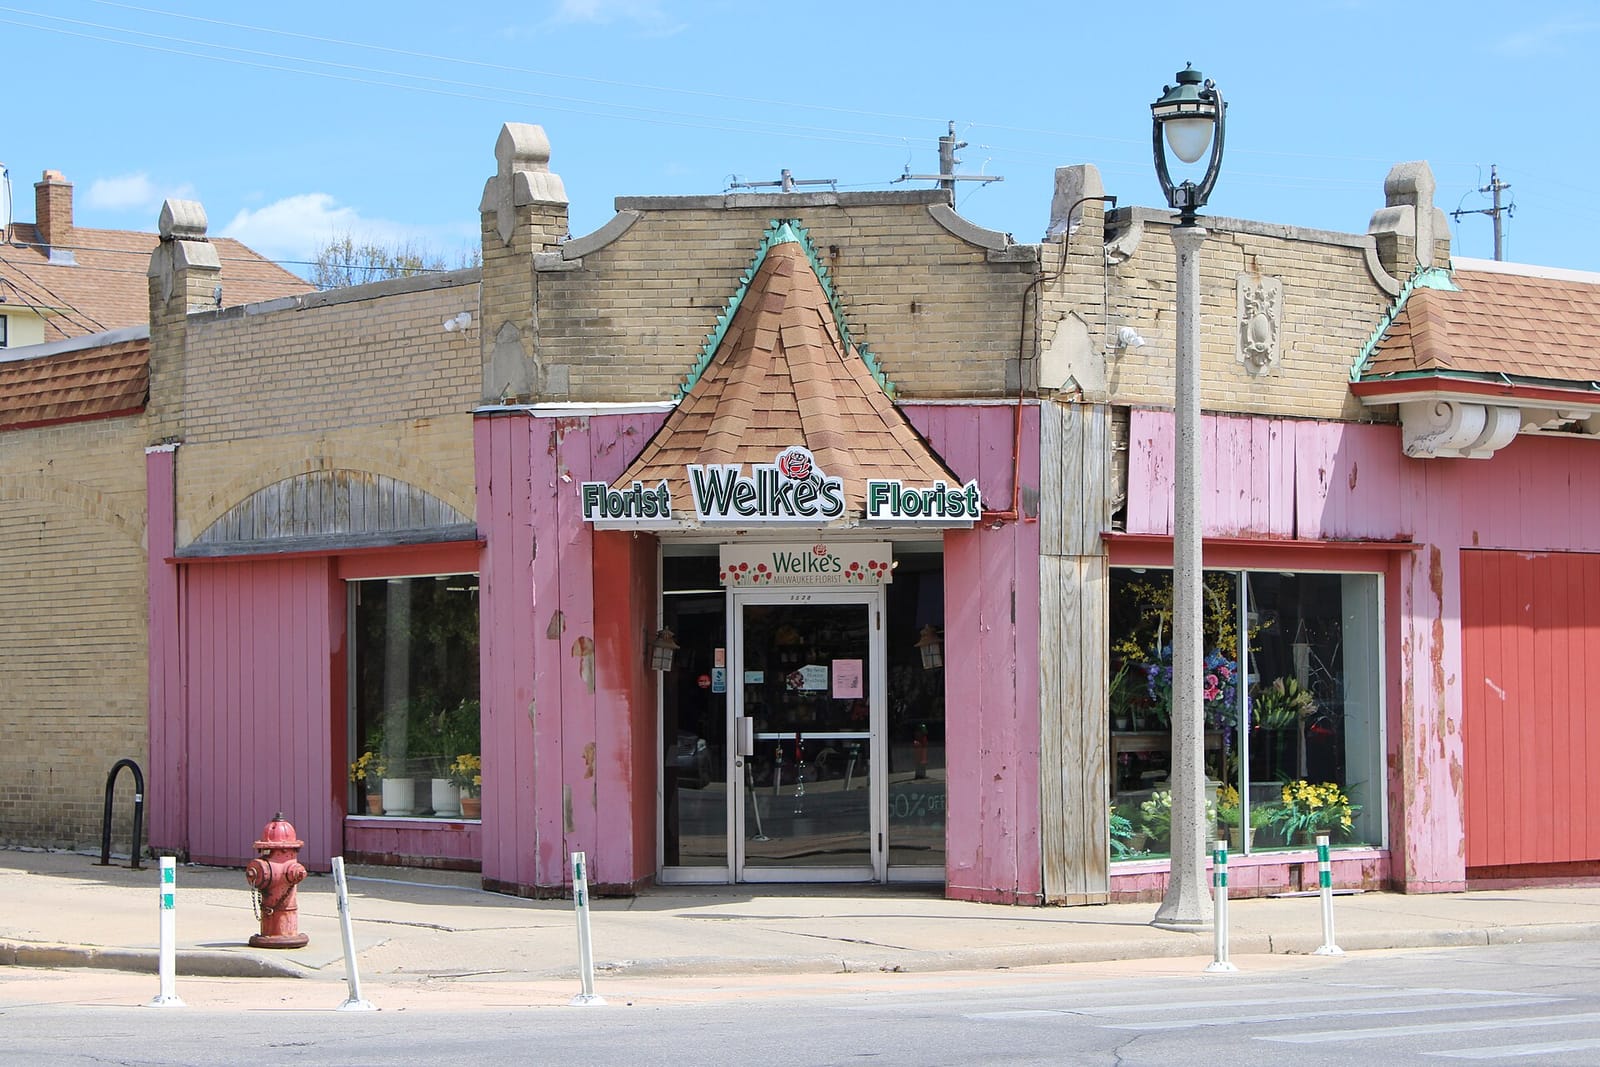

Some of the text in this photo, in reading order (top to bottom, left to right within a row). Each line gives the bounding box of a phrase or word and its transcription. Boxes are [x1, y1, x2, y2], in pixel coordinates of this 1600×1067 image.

[583, 482, 670, 518] Florist
[691, 467, 844, 517] Welke's
[869, 482, 979, 517] Florist
[772, 552, 842, 573] Welke's
[773, 574, 842, 585] MILWAUKEE FLORIST
